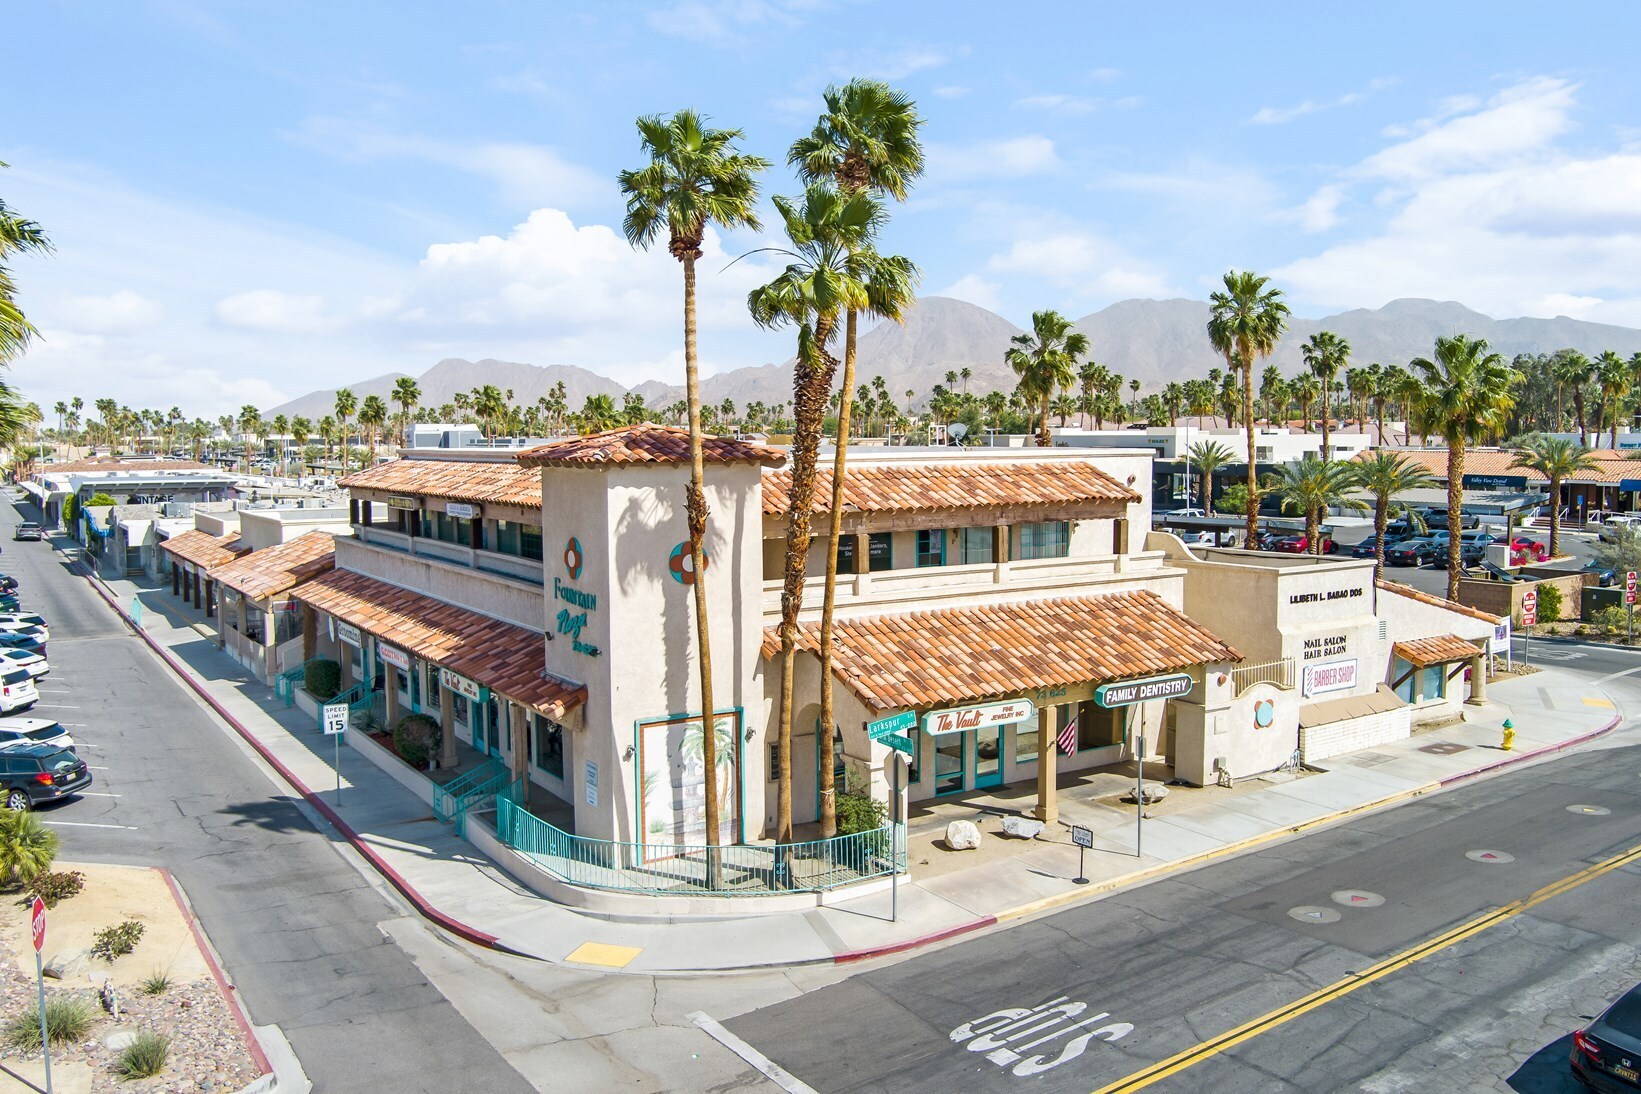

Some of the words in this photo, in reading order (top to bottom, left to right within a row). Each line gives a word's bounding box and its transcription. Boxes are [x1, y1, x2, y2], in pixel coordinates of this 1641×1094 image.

[1290, 593, 1318, 604] LILIBETH
[1327, 590, 1348, 600] BABAO
[1350, 588, 1362, 597] DDS
[1304, 638, 1322, 649] NAIL
[1324, 635, 1347, 647] SALON
[1304, 650, 1321, 660] HAIR
[1324, 645, 1346, 656] SALON
[1314, 668, 1337, 687] BARBER
[1339, 666, 1354, 683] SHOP
[1106, 687, 1137, 703] FAMILY
[1140, 680, 1187, 697] DENTISTRY
[937, 714, 953, 732] The
[956, 709, 983, 729] Vault
[991, 712, 1014, 721] JEWELRY
[329, 720, 344, 731] 15
[869, 717, 900, 734] Larkspur
[1074, 835, 1091, 845] OPEN
[33, 908, 45, 941] STOP
[950, 996, 1134, 1076] STOP
